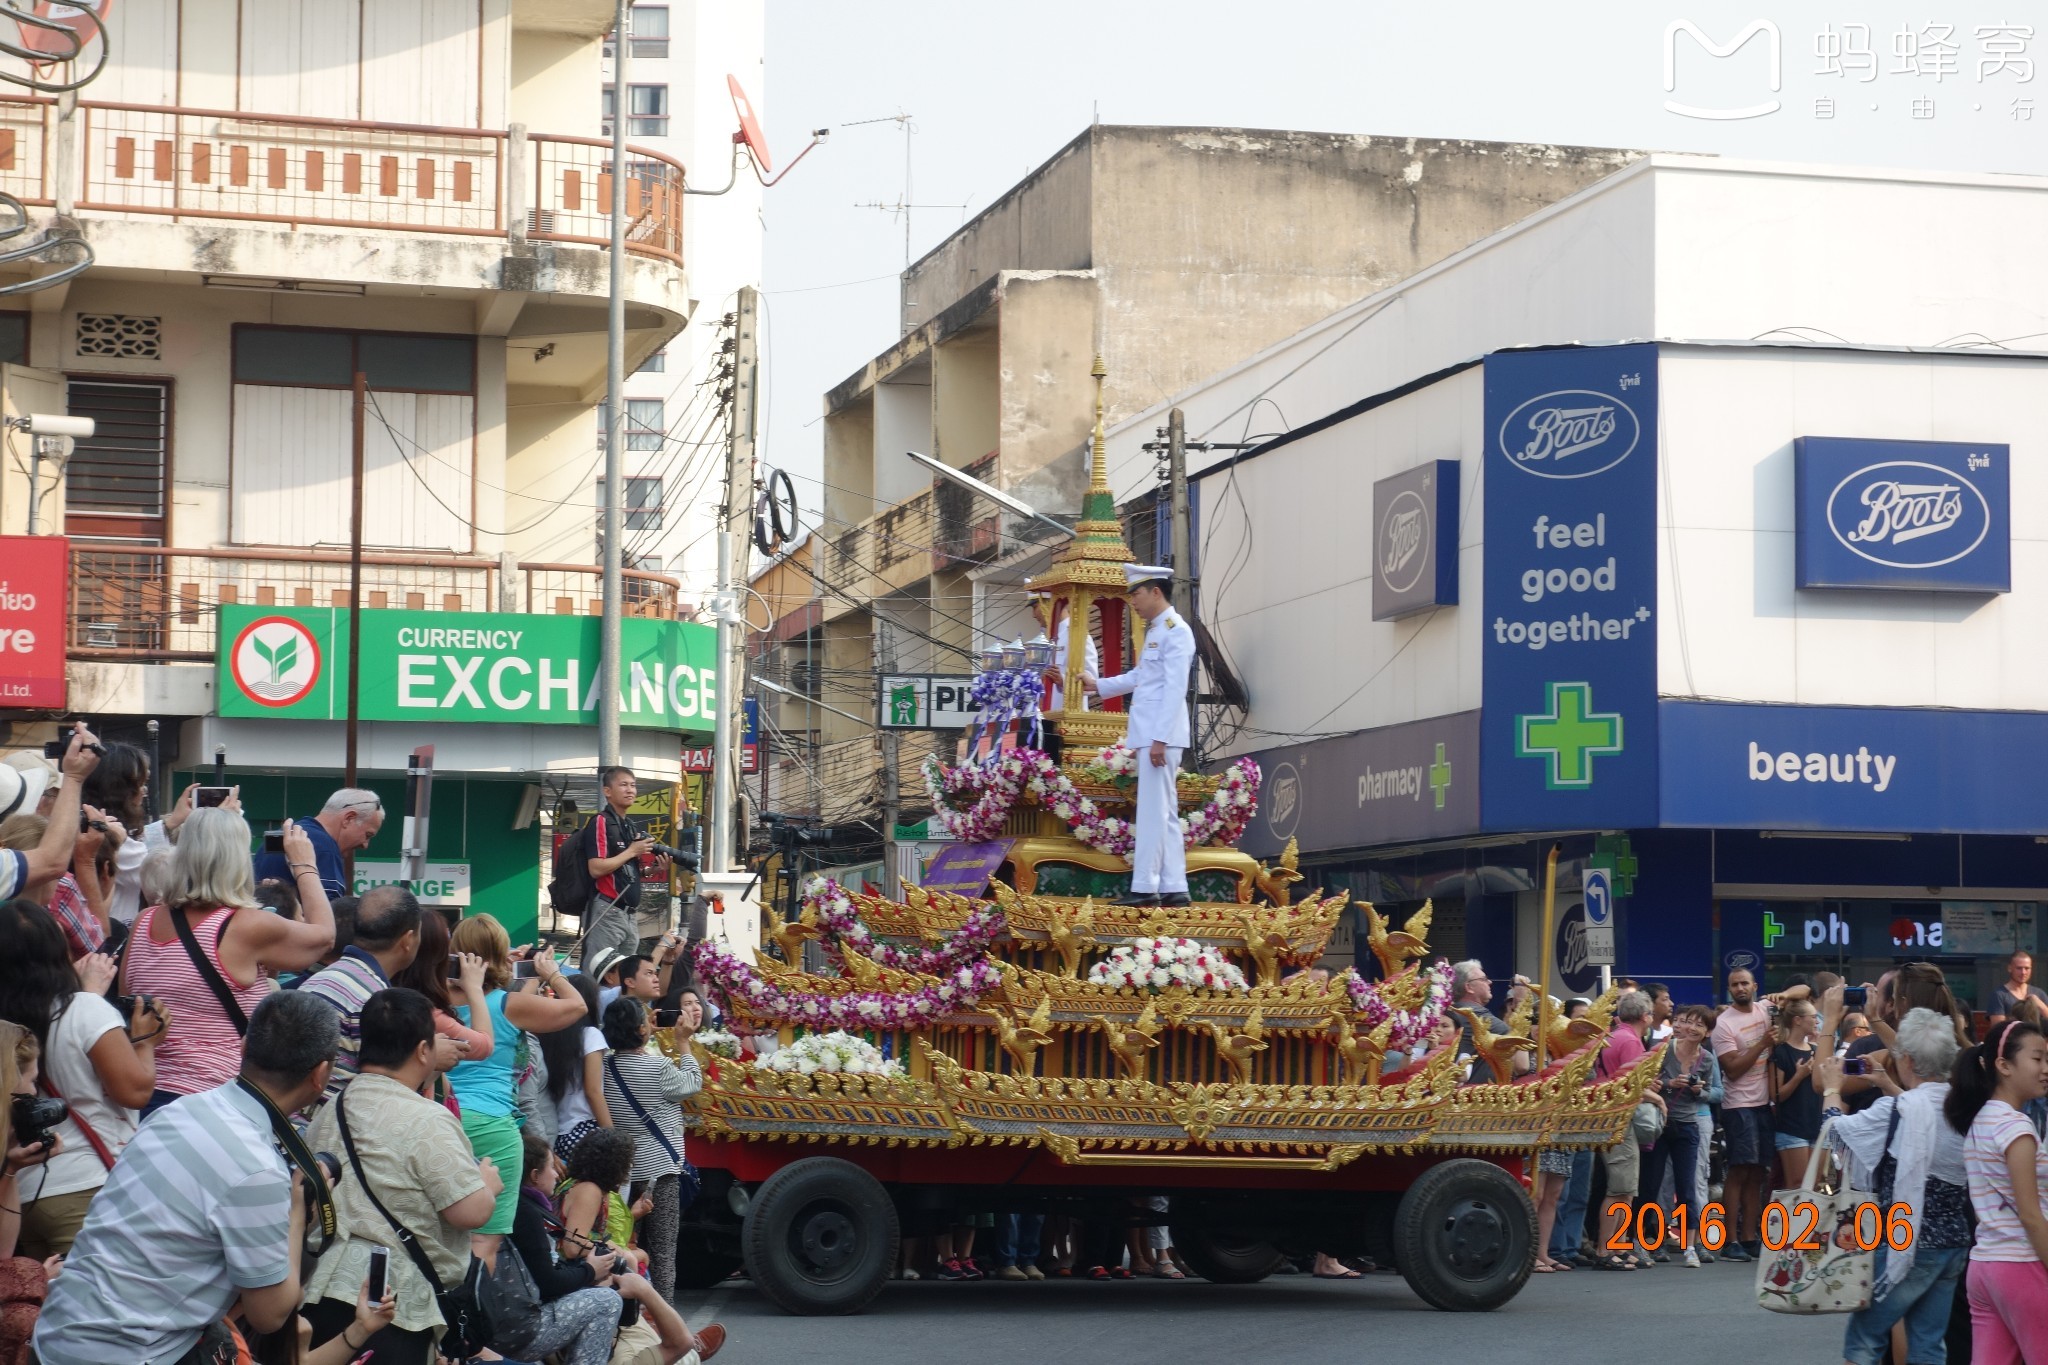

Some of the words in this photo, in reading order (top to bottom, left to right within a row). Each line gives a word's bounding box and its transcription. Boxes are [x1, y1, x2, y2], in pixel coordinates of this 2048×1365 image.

[1517, 404, 1616, 461] Boots
[1532, 512, 1606, 550] feel
[1848, 480, 1963, 545] Boots
[1384, 507, 1422, 574] Boots
[1521, 556, 1616, 603] good
[398, 627, 523, 650] CURRENCY
[1358, 765, 1423, 809] pharmacy
[1748, 741, 1897, 793] beauty
[1270, 777, 1298, 824] Boots
[323, 1203, 334, 1236] Nikon
